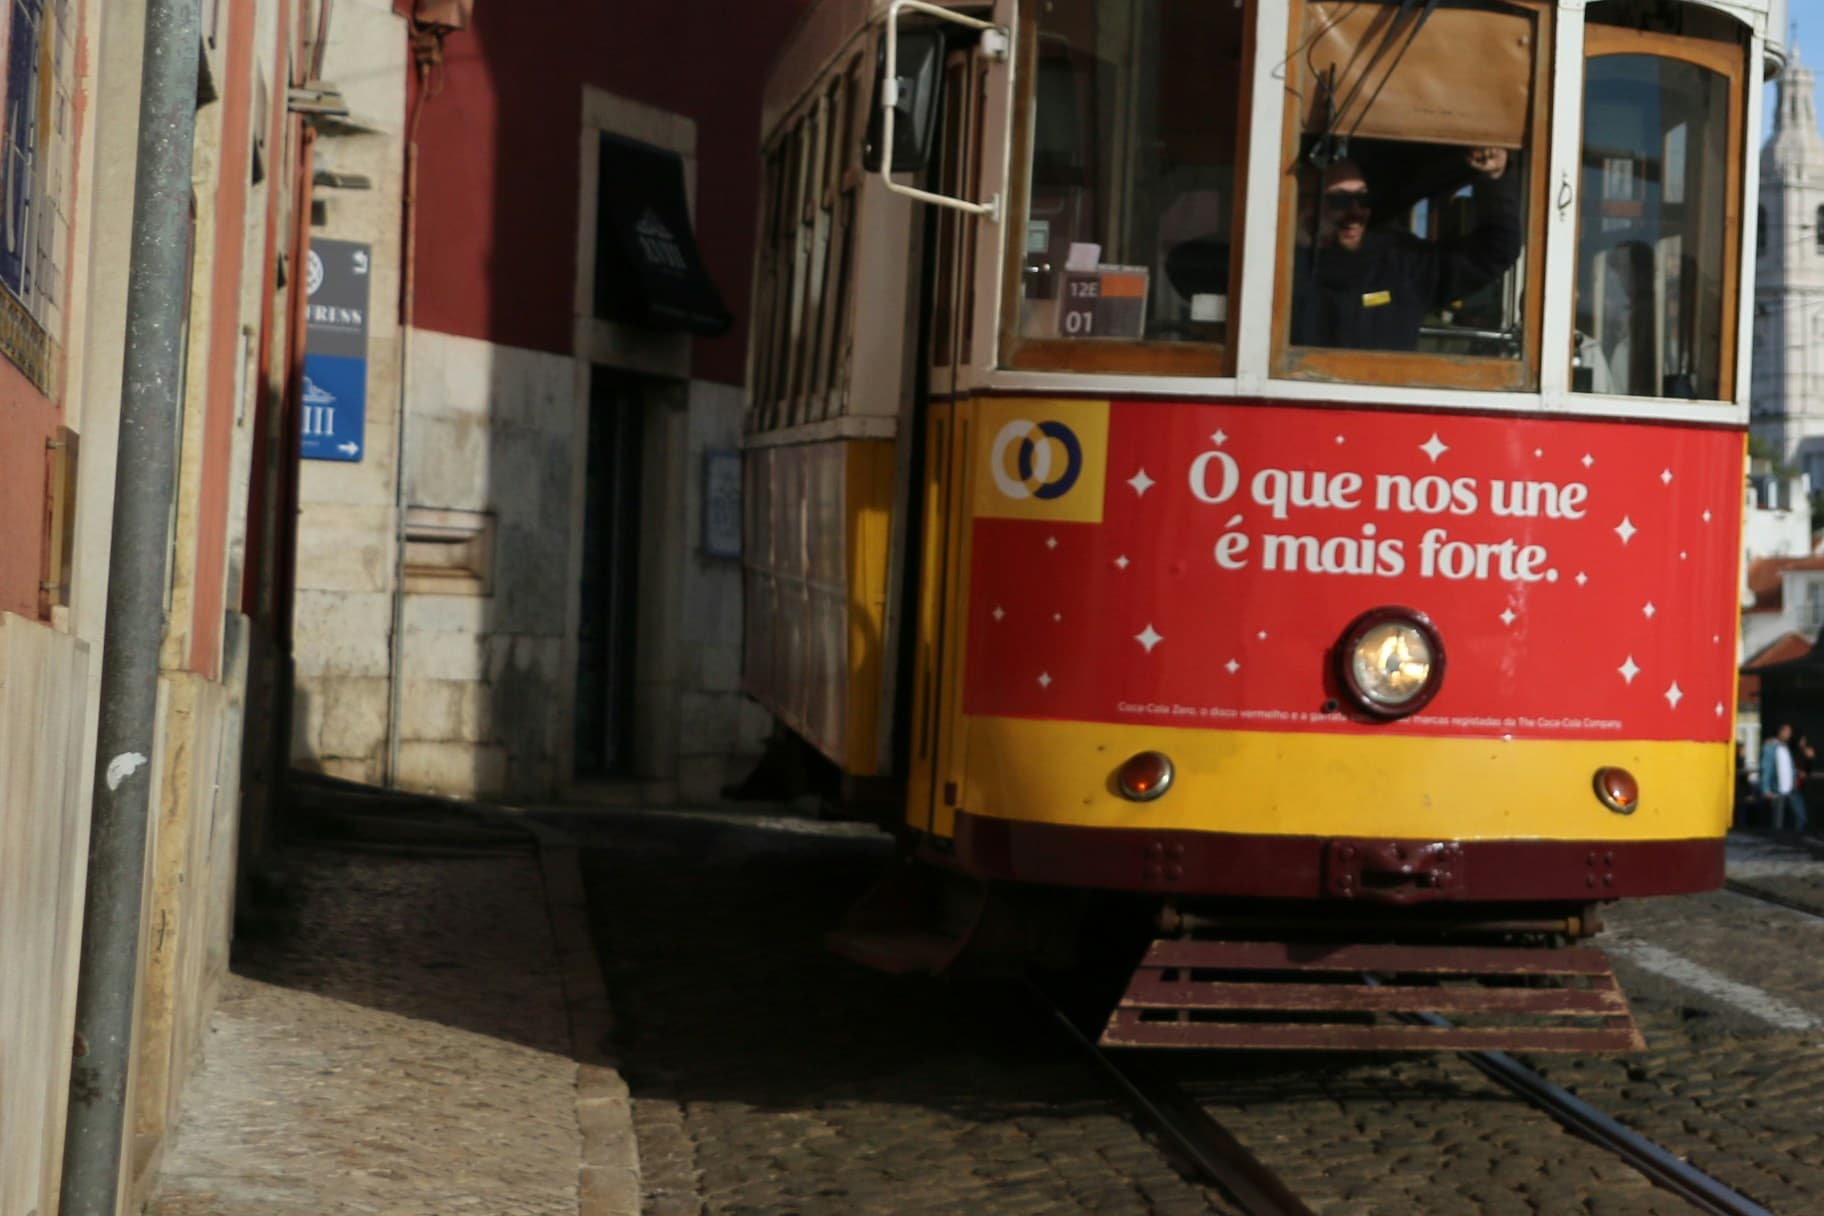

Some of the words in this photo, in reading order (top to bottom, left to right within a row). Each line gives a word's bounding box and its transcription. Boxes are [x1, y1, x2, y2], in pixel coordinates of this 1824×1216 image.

[1065, 311, 1093, 334] 01
[1189, 450, 1239, 504] O
[1251, 468, 1363, 519] que
[1375, 474, 1478, 516] nos
[1490, 479, 1588, 520] une
[1215, 514, 1249, 570] é
[1263, 523, 1405, 577] mais
[1419, 527, 1559, 585] forte.
